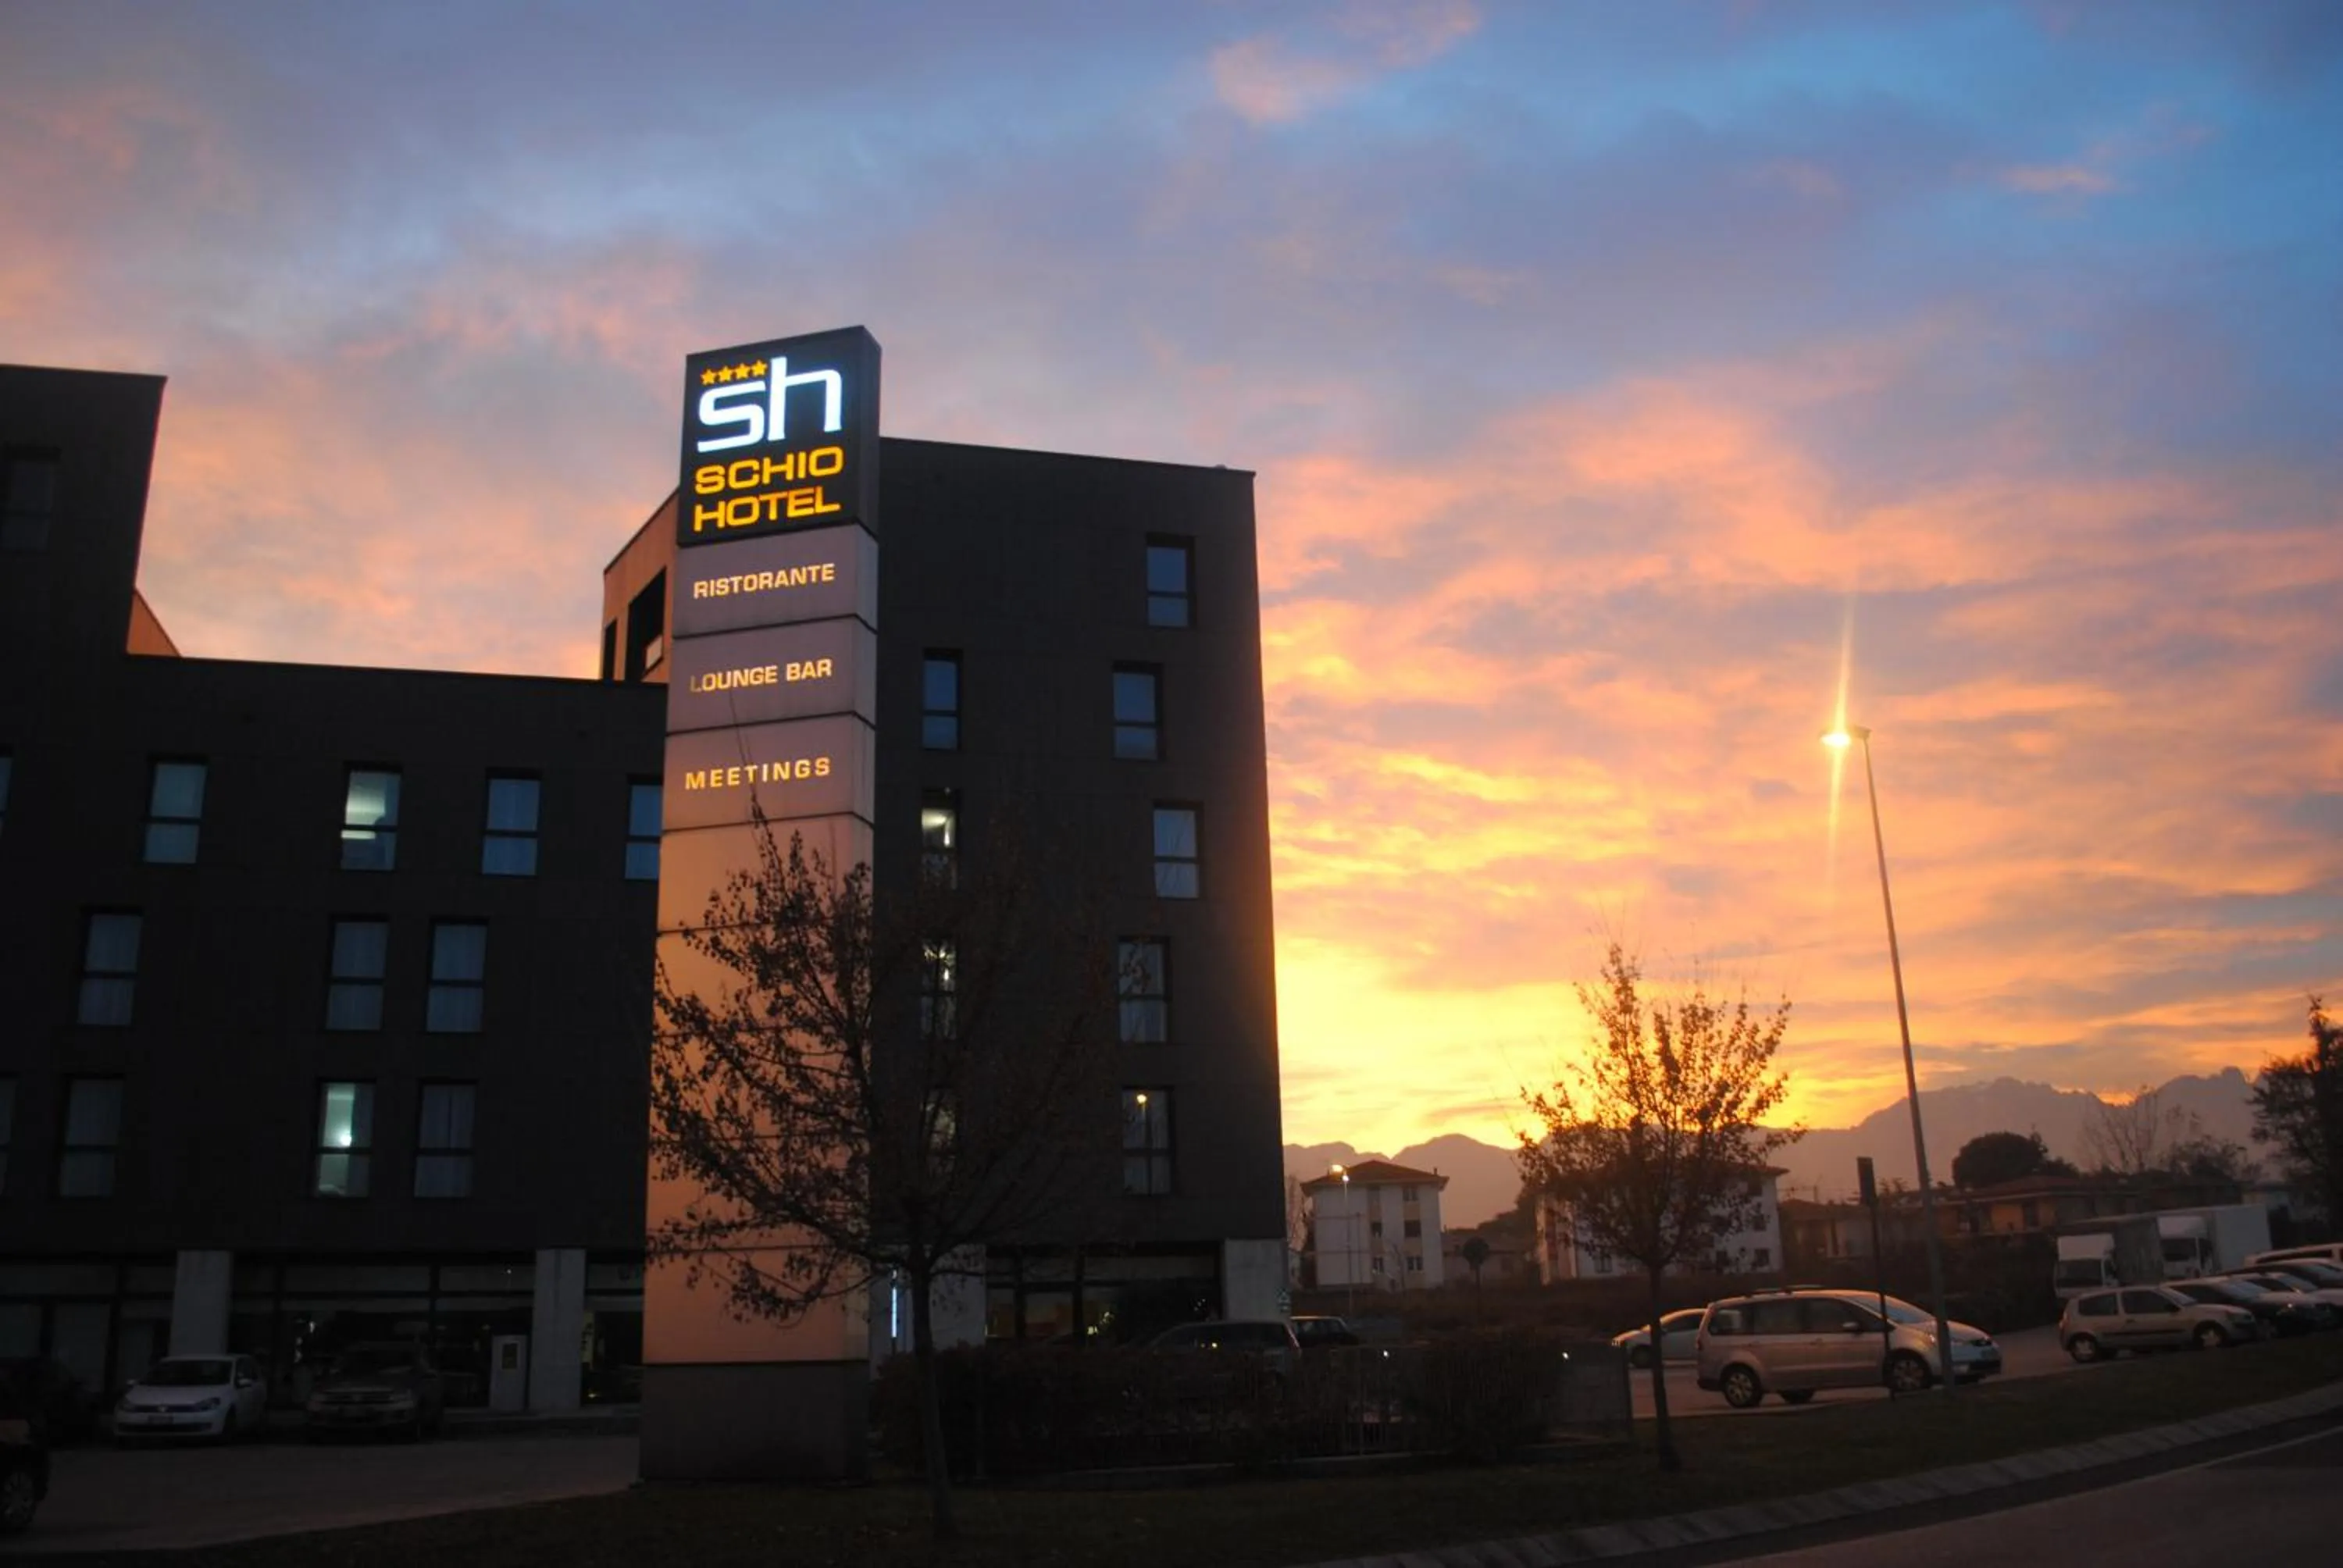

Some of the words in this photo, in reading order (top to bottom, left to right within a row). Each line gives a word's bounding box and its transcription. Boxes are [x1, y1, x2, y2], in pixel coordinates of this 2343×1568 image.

[697, 357, 841, 452] sh
[694, 447, 843, 494] SCHIO
[694, 486, 841, 532] HOTEL
[694, 563, 836, 599] RISTORANTE
[690, 665, 778, 692] LOUNGE
[786, 659, 833, 682] BAR
[685, 757, 830, 789] MEETINGS
